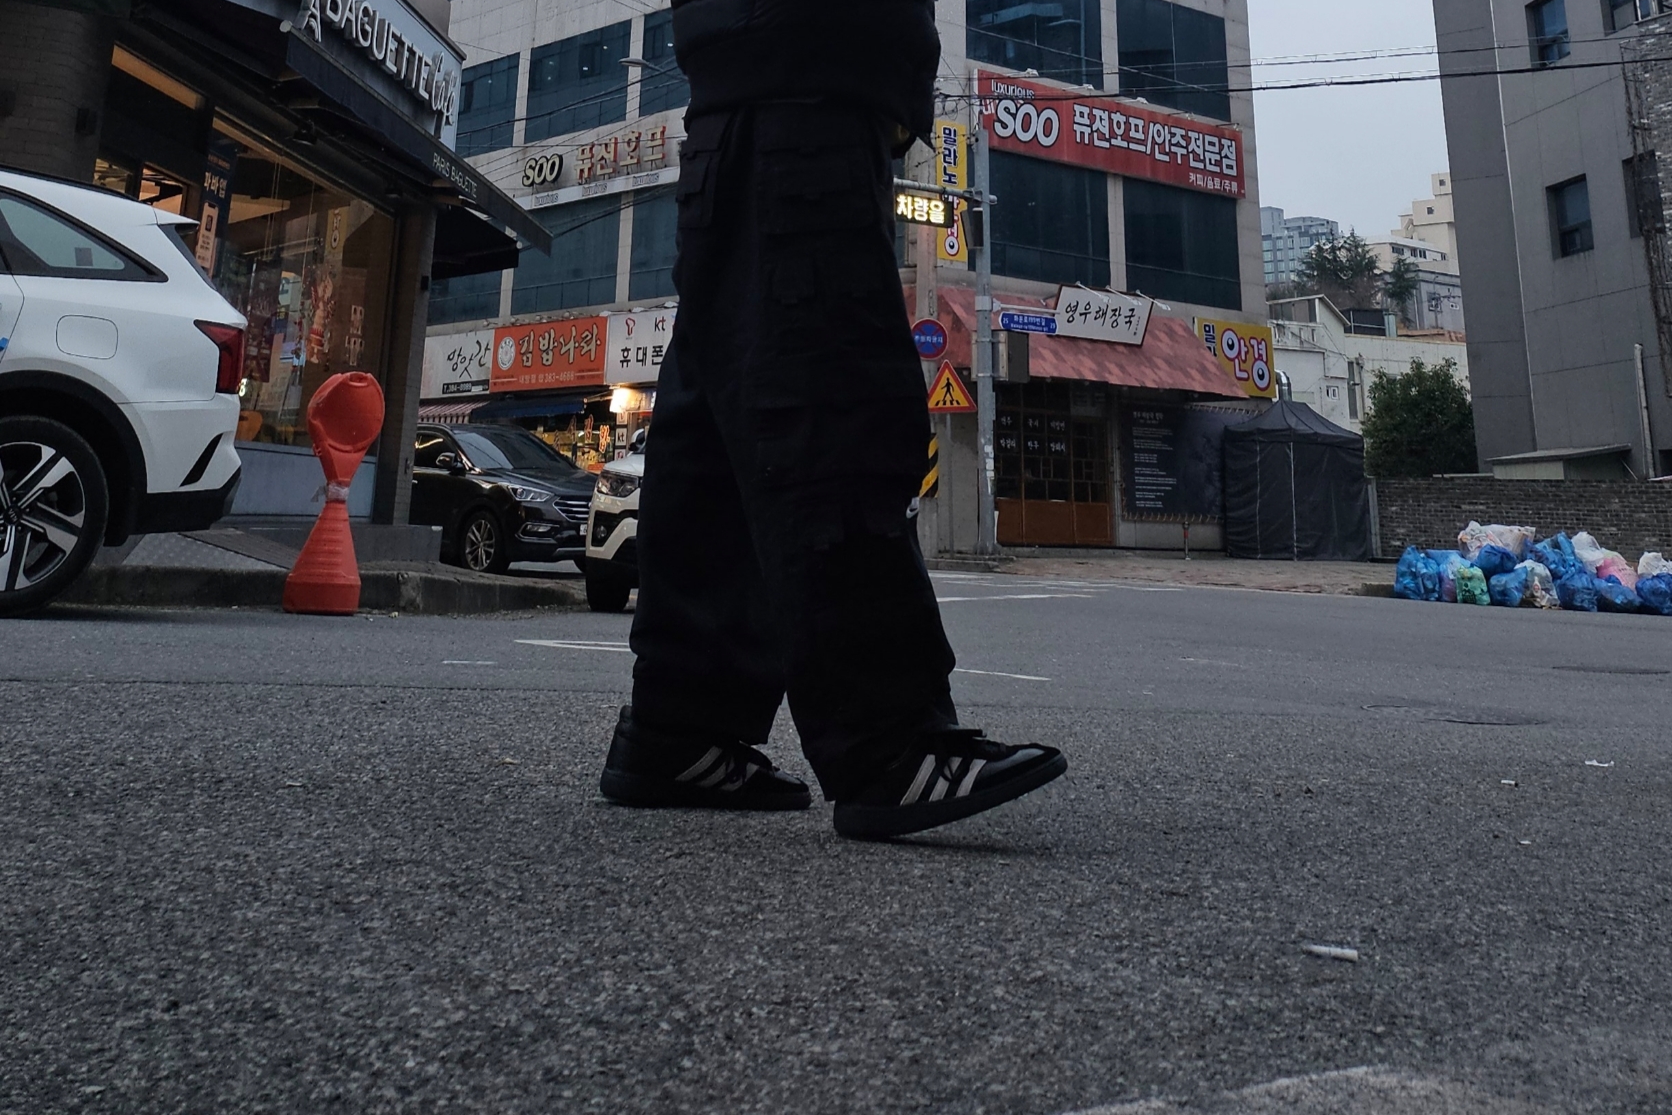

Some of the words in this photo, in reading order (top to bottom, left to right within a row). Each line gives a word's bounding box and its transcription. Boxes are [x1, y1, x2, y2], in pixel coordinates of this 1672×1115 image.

[991, 78, 1035, 99] luxurious
[994, 98, 1060, 148] SOO
[523, 153, 562, 186] SOO
[942, 126, 957, 185] 밀라노
[432, 152, 450, 177] PARIS
[450, 166, 477, 198] BAGUETTE
[896, 193, 945, 224] 차량을
[655, 316, 666, 332] kt
[1065, 300, 1136, 331] 영우해장국
[519, 323, 601, 369] 김밥나라
[619, 344, 665, 369] 휴대폰
[1221, 328, 1271, 391] 안경
[617, 432, 625, 444] kt
